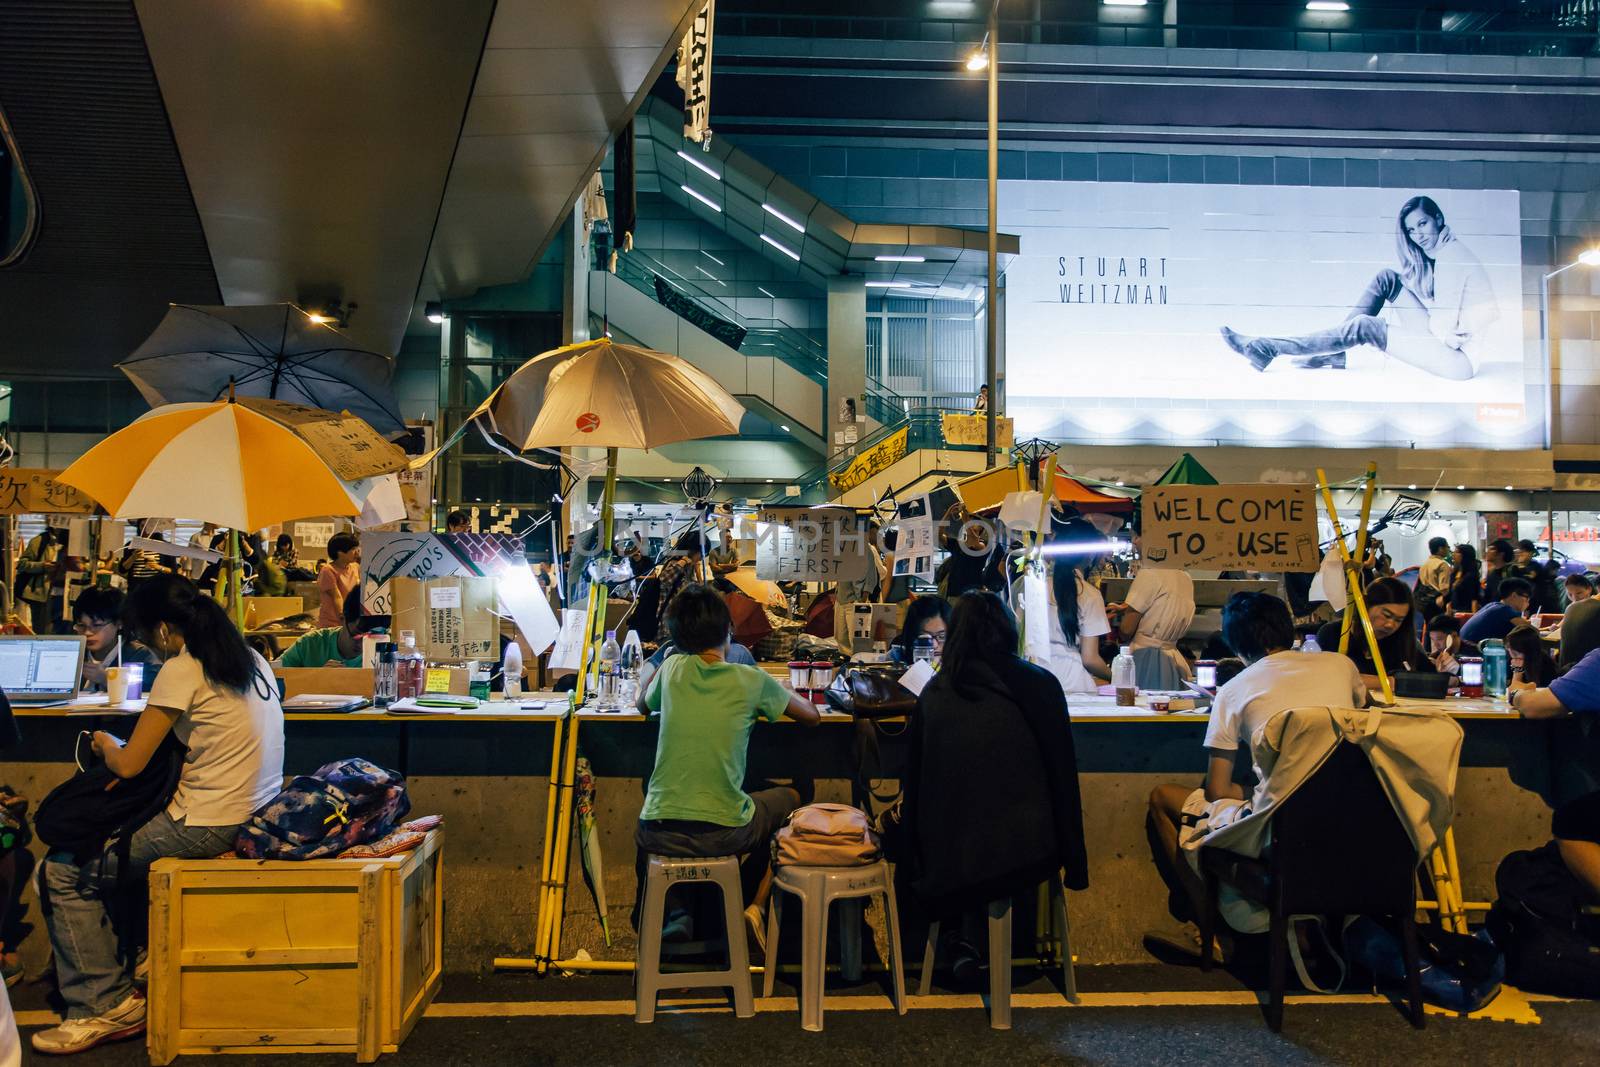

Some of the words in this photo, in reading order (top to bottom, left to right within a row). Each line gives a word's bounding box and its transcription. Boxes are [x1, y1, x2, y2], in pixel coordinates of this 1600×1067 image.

[1059, 256, 1167, 277] STUART
[1060, 284, 1167, 305] WEITZMAN
[1152, 497, 1305, 524] WELCOME
[1167, 532, 1206, 555] TO
[1237, 532, 1290, 557] USE
[1537, 526, 1598, 543] Audi
[779, 557, 843, 574] FIRST
